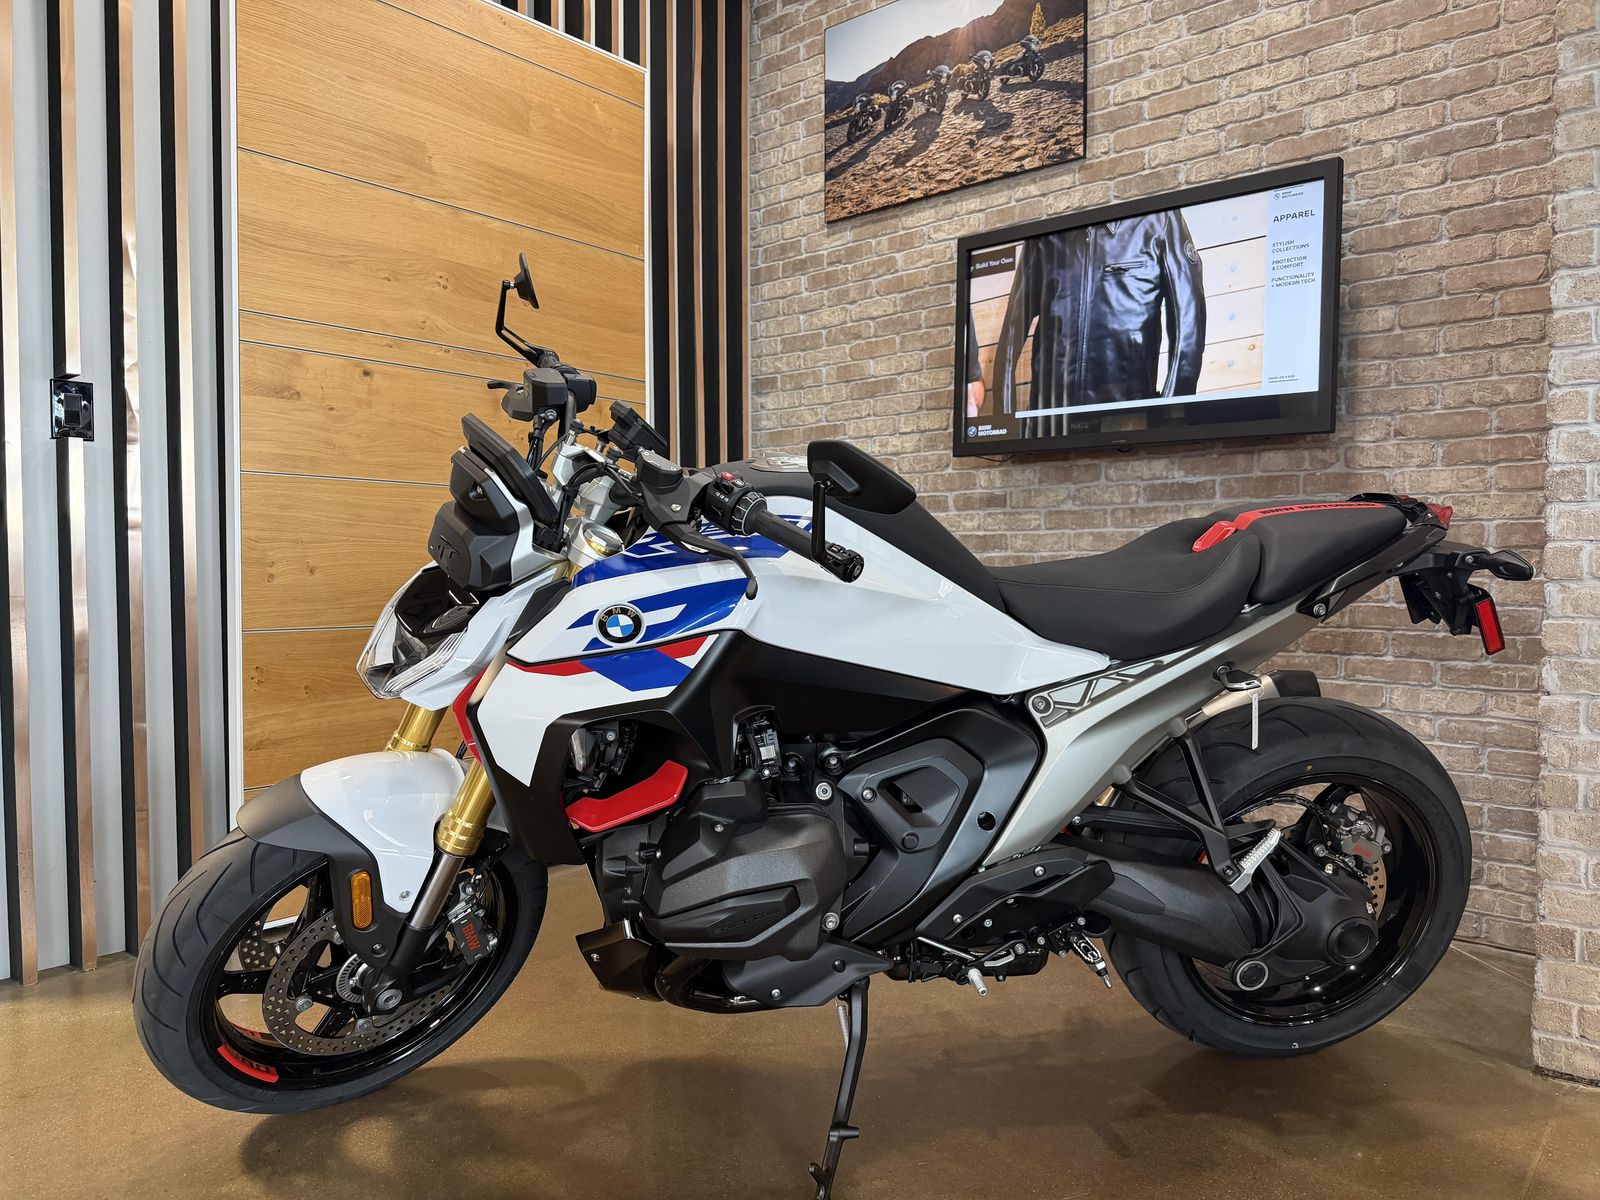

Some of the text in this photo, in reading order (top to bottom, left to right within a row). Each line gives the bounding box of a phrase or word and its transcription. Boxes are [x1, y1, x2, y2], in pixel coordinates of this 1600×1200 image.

[1273, 210, 1315, 223] APPAREL
[1272, 243, 1309, 253] COLLECTIONS
[975, 261, 989, 270] Build
[989, 259, 1000, 267] Your
[1000, 257, 1014, 265] Own
[1272, 256, 1307, 265] PROTECTION
[1276, 262, 1303, 270] COMFORT
[1272, 272, 1314, 282] FUNCTIONALITY
[1275, 280, 1300, 288] MODERN
[1300, 277, 1316, 285] TECH
[978, 428, 1008, 436] MOTORRAD
[600, 607, 636, 622] BMW
[463, 923, 480, 950] BMW
